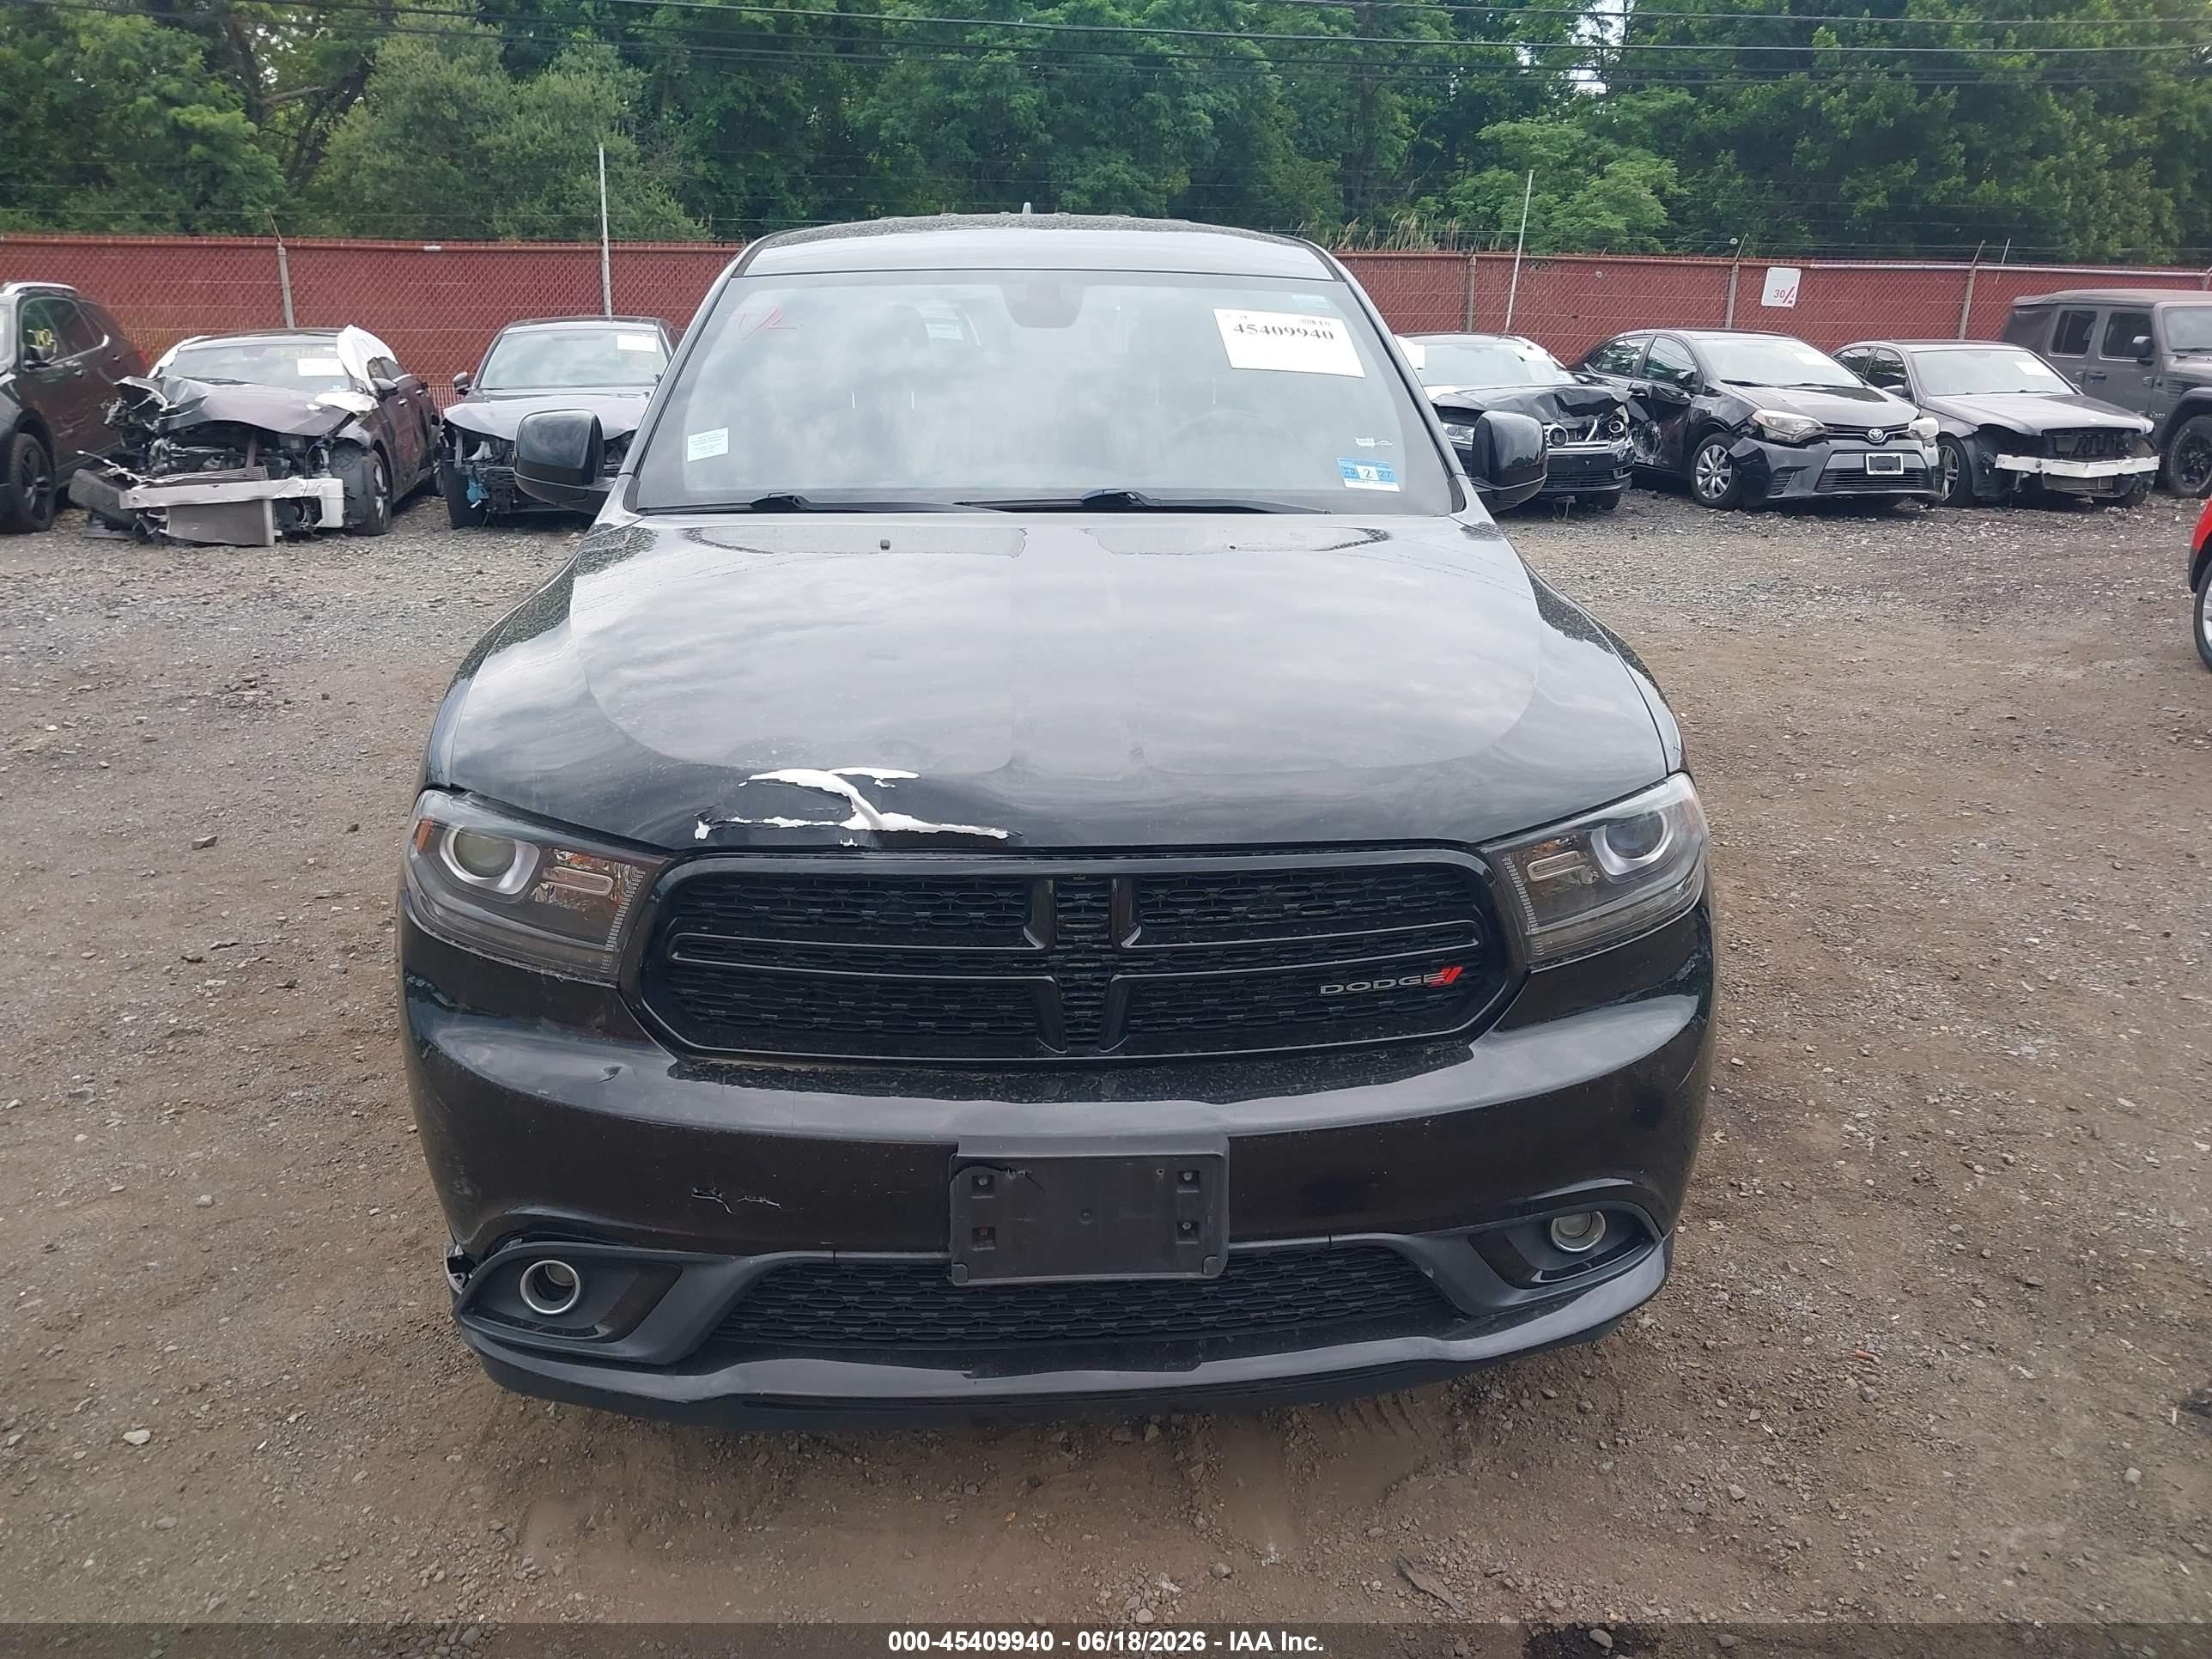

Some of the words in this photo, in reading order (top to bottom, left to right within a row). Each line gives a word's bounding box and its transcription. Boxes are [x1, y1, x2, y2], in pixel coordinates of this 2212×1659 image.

[1233, 323, 1334, 340] 45409940
[1363, 467, 1373, 478] 2
[1320, 971, 1445, 995] DODGE
